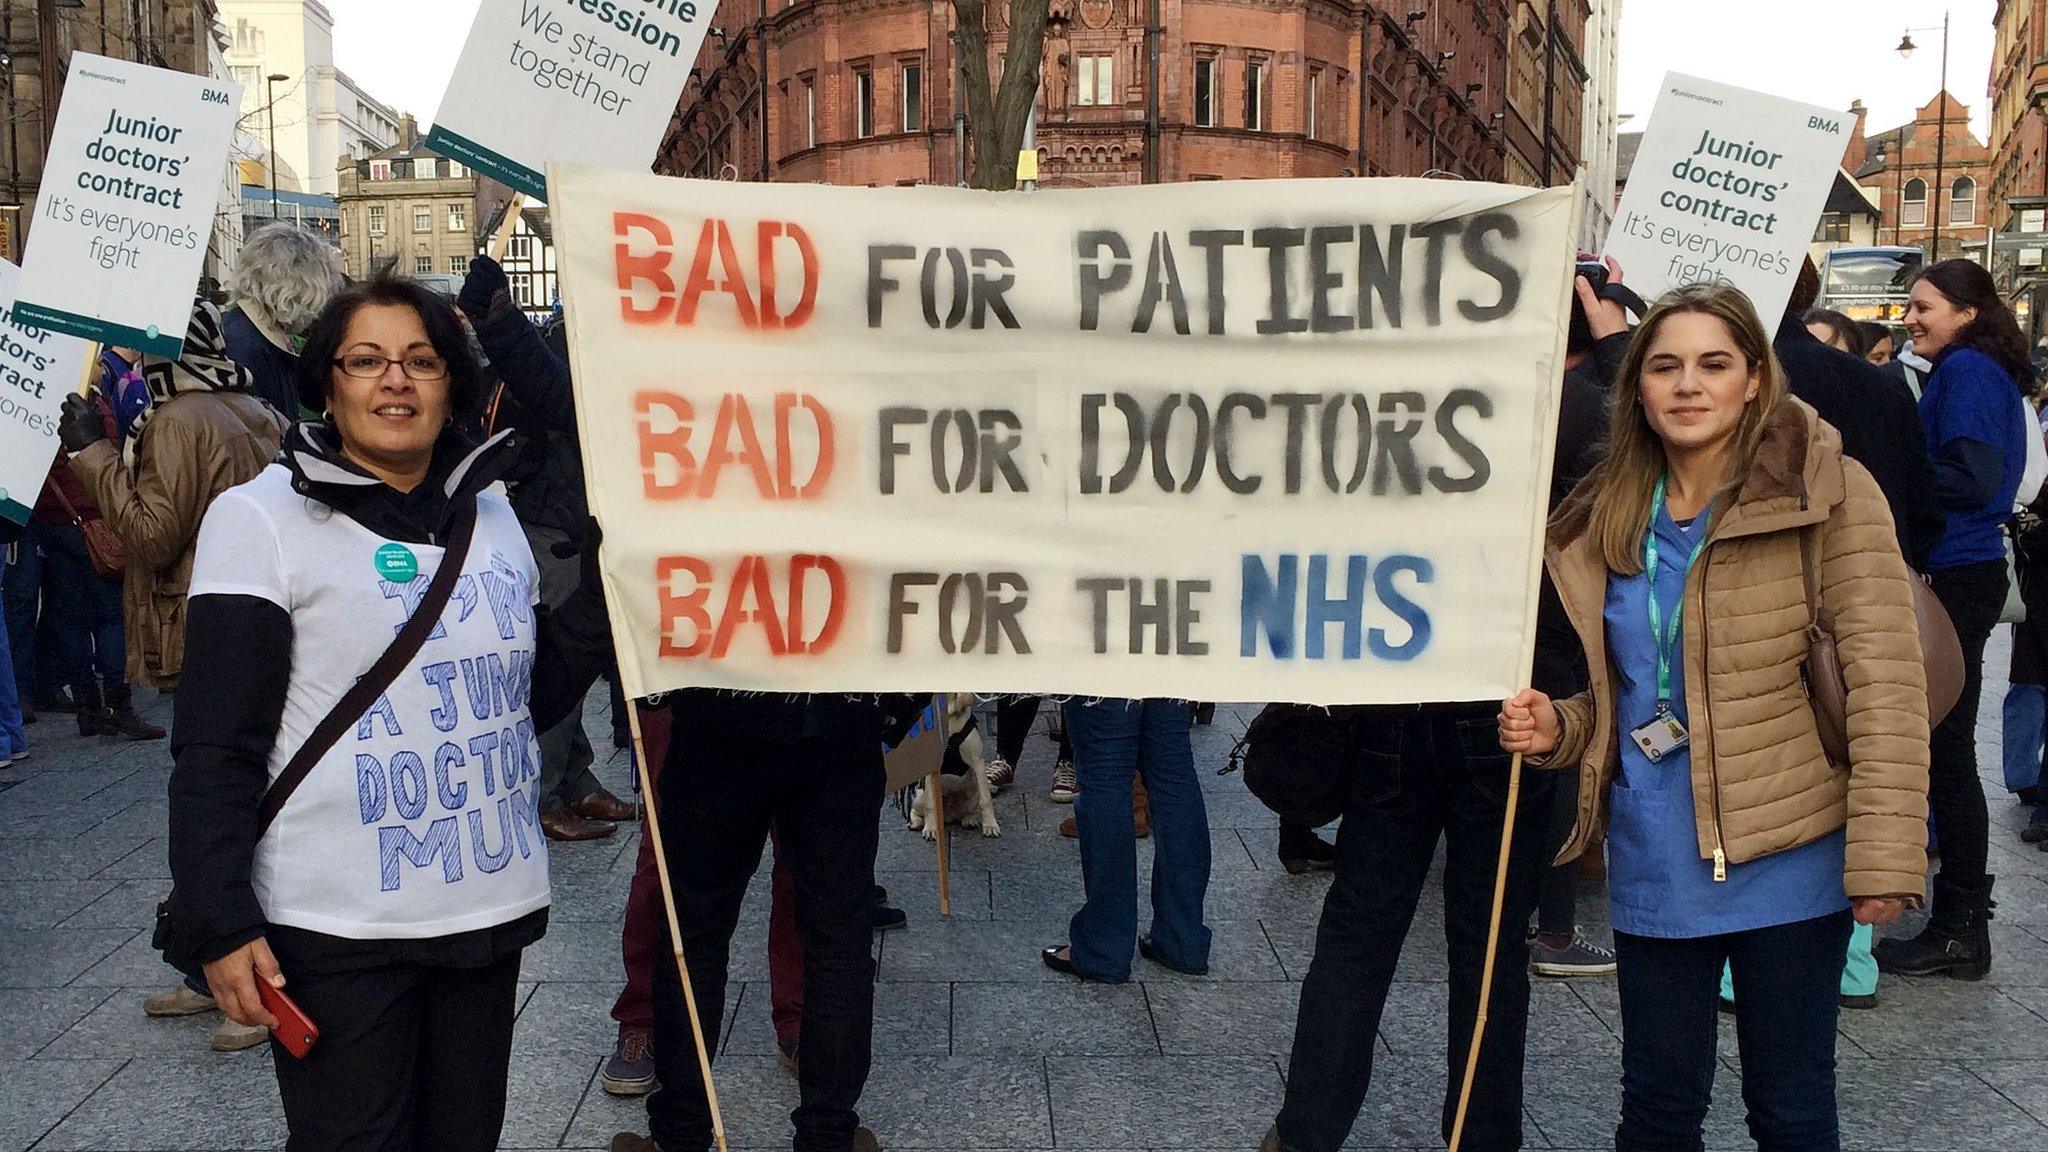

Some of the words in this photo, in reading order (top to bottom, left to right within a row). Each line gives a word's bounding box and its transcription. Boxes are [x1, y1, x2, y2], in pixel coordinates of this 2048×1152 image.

[567, 0, 681, 57] ession
[642, 0, 697, 22] ne
[521, 0, 563, 43] We
[568, 33, 651, 86] stand
[201, 88, 229, 105] BMA
[510, 39, 632, 116] together
[103, 109, 183, 144] Junior
[1808, 115, 1840, 135] BMA
[86, 137, 190, 177] doctors’
[1693, 129, 1783, 170] Junior
[77, 171, 183, 209] contract
[1672, 158, 1788, 202] doctors’
[46, 194, 75, 222] It’s
[80, 207, 198, 249] everyone’s
[1660, 190, 1777, 235] contract
[90, 236, 141, 269] fight
[1623, 211, 1656, 239] It’s
[1660, 226, 1790, 275] everyone’s
[612, 212, 820, 331] BAD
[866, 243, 1023, 331] FOR
[1077, 212, 1522, 336] PATIENTS
[0, 396, 56, 437] one’s
[632, 389, 836, 503] BAD
[878, 407, 1030, 496] FOR
[1079, 388, 1495, 496] DOCTORS
[655, 553, 850, 661] BAD
[886, 571, 1032, 655] FOR
[1075, 577, 1211, 656] THE
[1238, 552, 1437, 662] NHS
[356, 677, 402, 741] A
[378, 777, 545, 892] MUM
